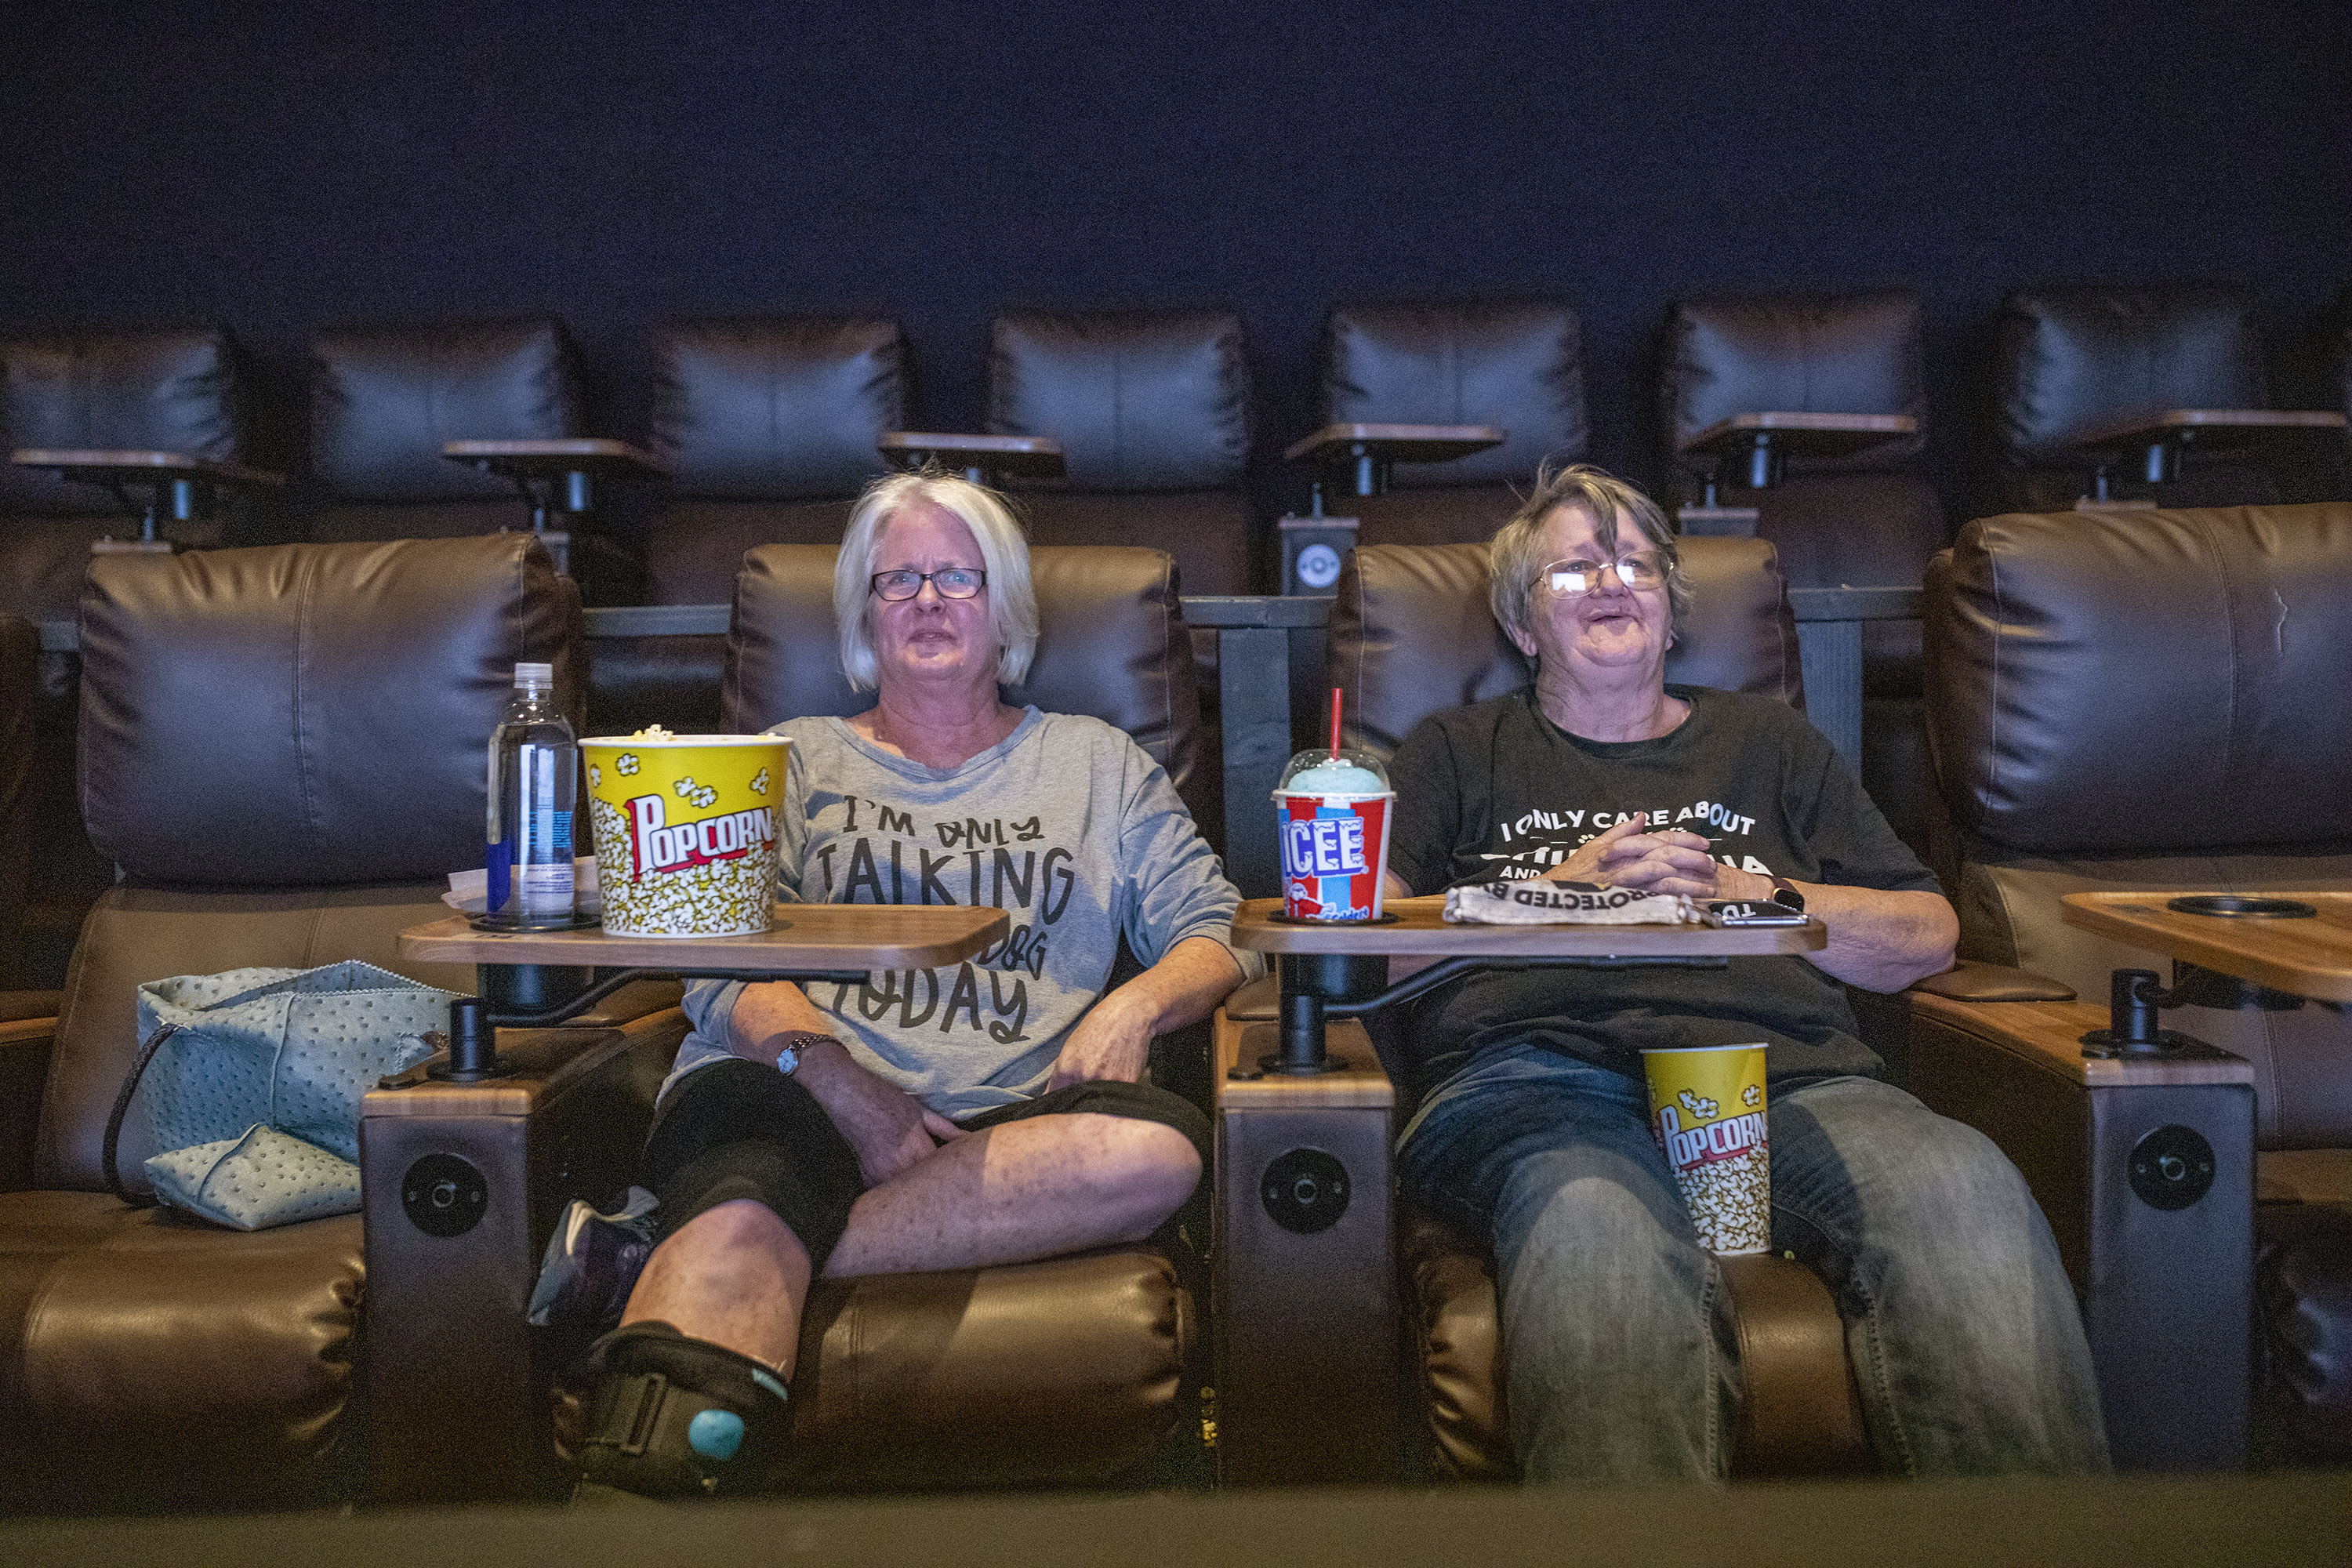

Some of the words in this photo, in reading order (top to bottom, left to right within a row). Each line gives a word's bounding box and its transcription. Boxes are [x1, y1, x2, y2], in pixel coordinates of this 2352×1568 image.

[626, 793, 773, 880] POPCORN
[843, 795, 915, 837] I'M
[935, 816, 1045, 849] ONLY
[1282, 819, 1365, 873] ICEE
[1501, 823, 1512, 842] I
[1515, 808, 1585, 835] ONLY
[1675, 800, 1755, 835] ABOUT
[1499, 866, 1541, 879] AND
[1658, 1104, 1768, 1169] POPCORN
